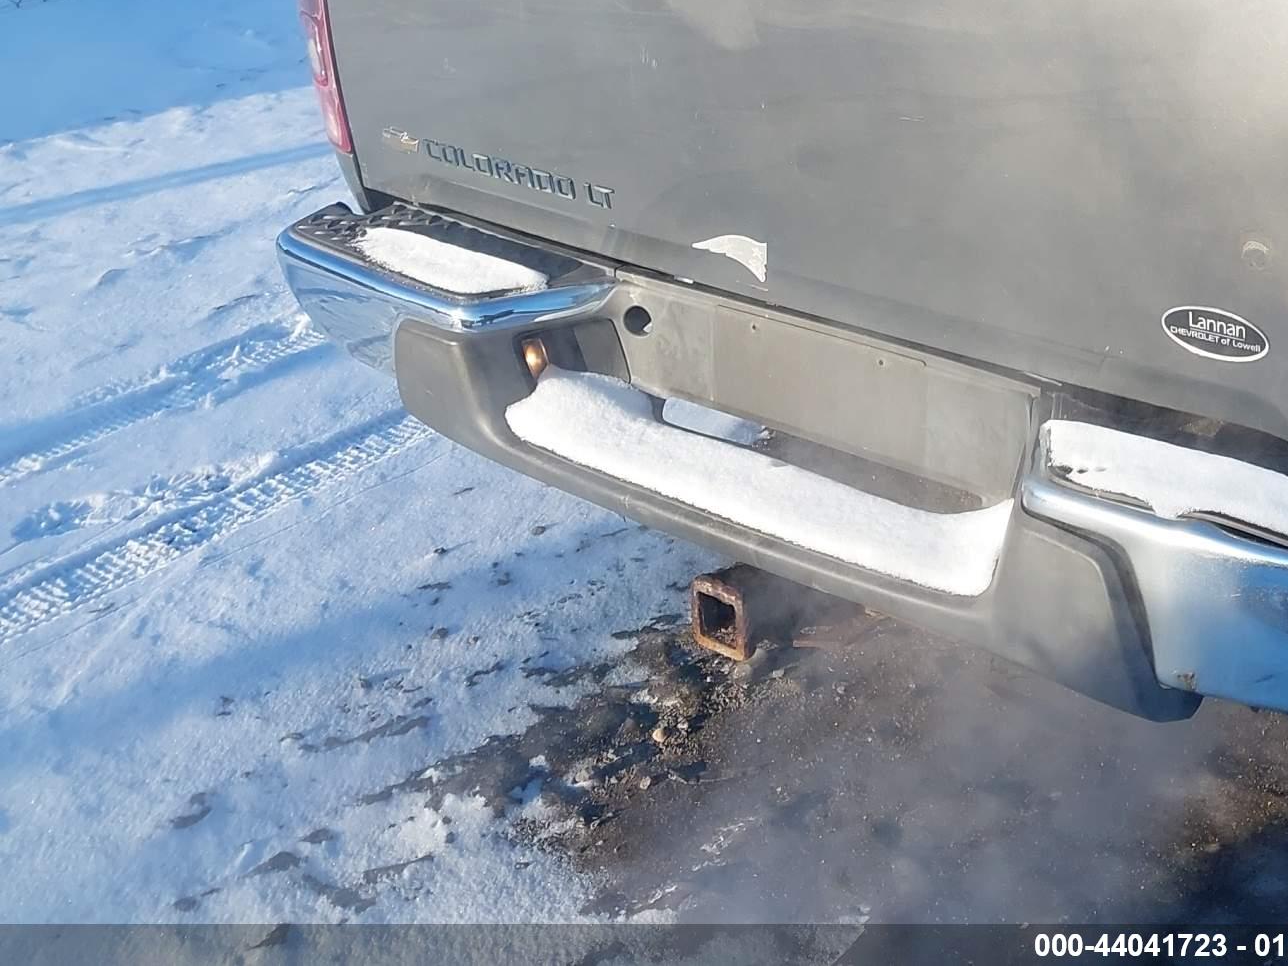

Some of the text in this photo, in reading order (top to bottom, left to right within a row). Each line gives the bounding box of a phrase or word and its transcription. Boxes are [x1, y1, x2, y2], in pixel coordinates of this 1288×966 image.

[422, 138, 616, 209] COLORADO LT
[1169, 325, 1262, 353] CHEVROLET of Lowell
[1187, 311, 1246, 339] Lannan
